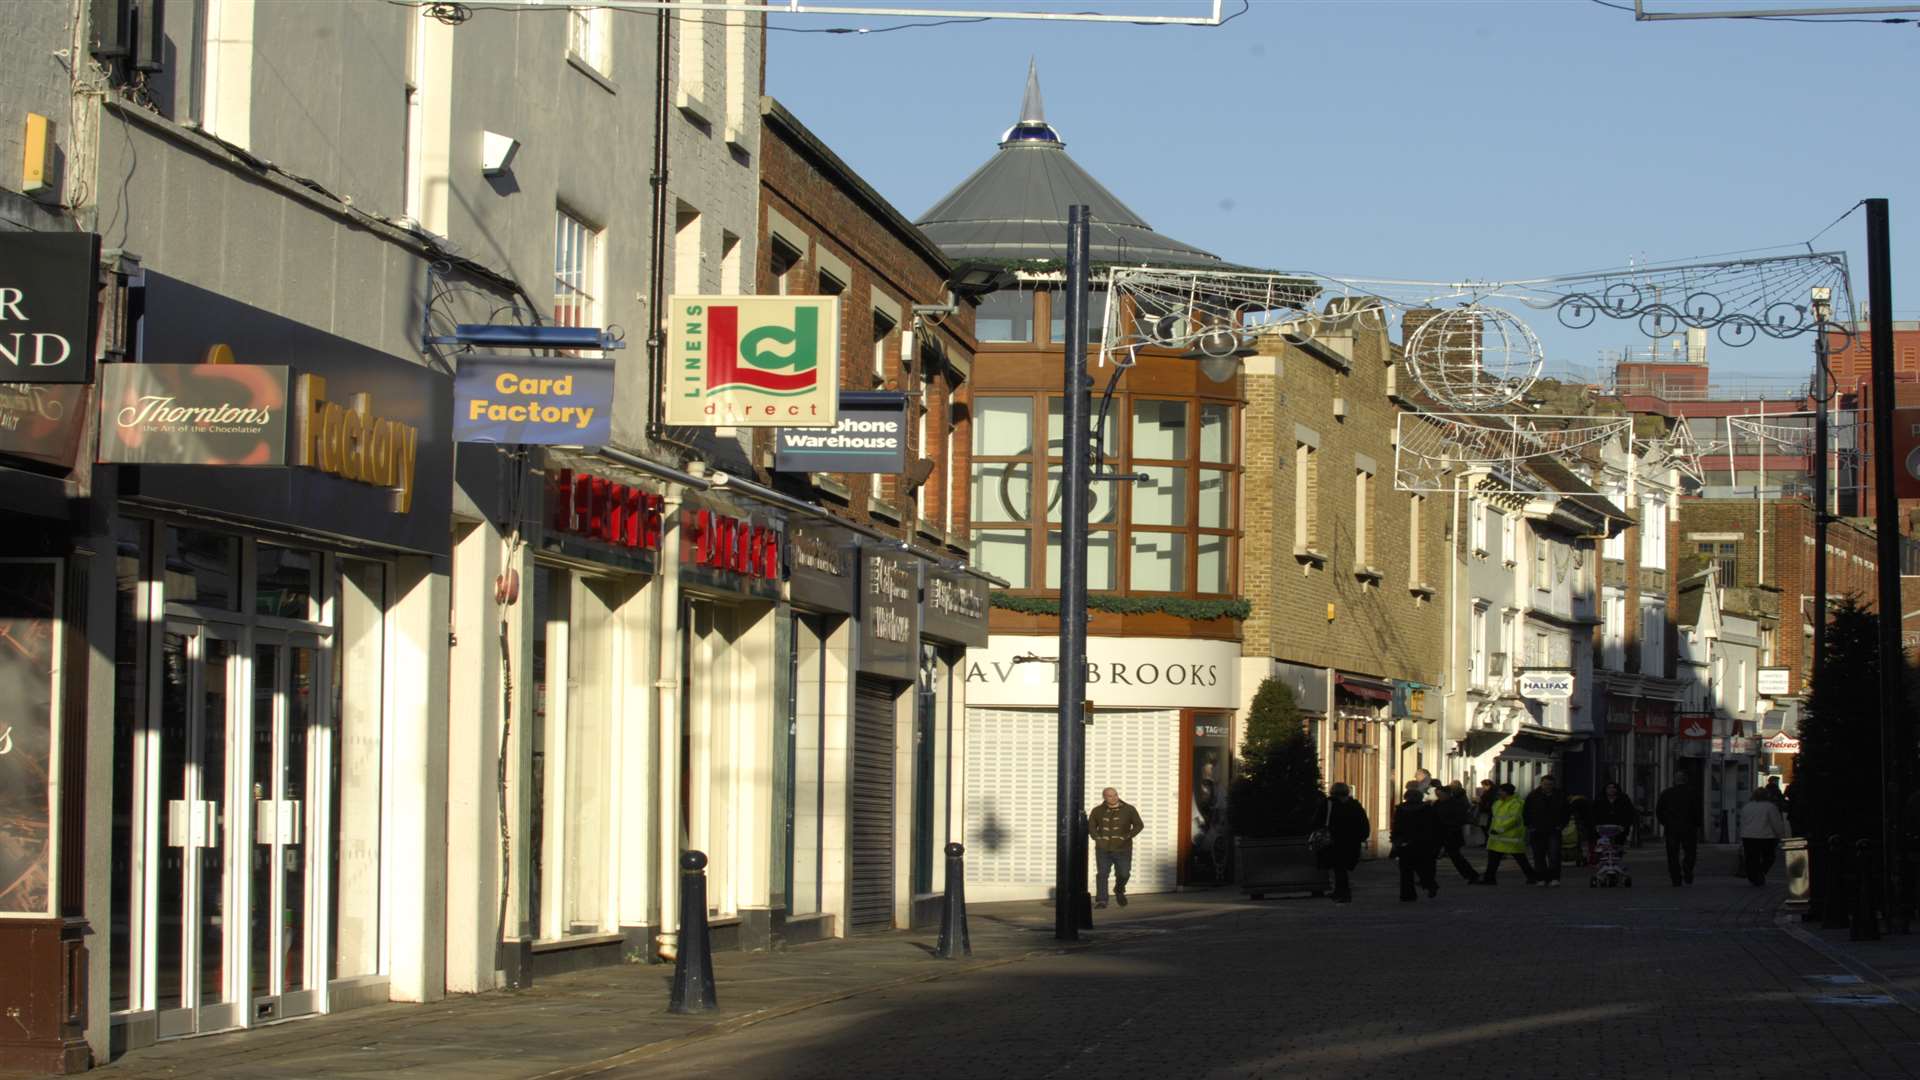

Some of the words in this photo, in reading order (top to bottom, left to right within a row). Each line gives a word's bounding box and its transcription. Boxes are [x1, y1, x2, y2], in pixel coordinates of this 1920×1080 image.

[685, 305, 703, 398] LINENS
[495, 372, 573, 396] Card
[117, 395, 271, 428] Thorntons
[468, 399, 595, 429] Factory
[704, 402, 817, 416] direct
[784, 434, 898, 448] Warehouse
[1085, 662, 1217, 686] BROOKS
[1523, 682, 1569, 690] HALIFAX
